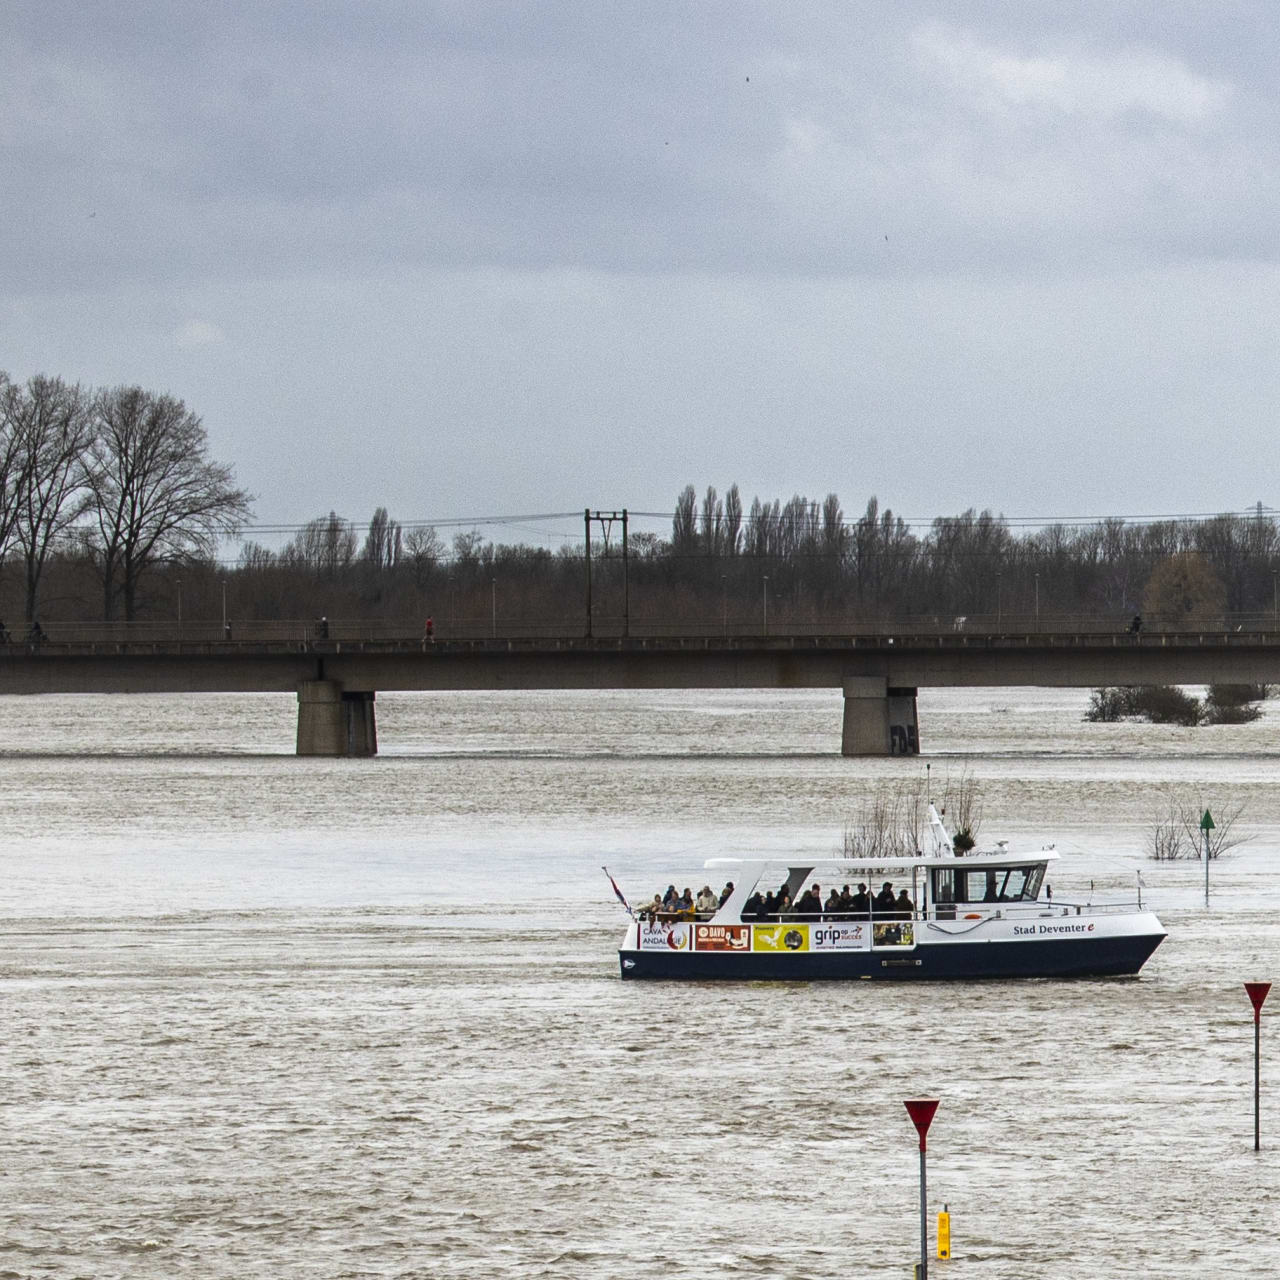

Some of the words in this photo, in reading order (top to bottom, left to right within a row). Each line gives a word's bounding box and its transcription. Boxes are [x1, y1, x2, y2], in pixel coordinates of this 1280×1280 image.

[815, 926, 840, 945] grip
[1013, 925, 1035, 935] Stad
[1039, 924, 1085, 934] Deventer
